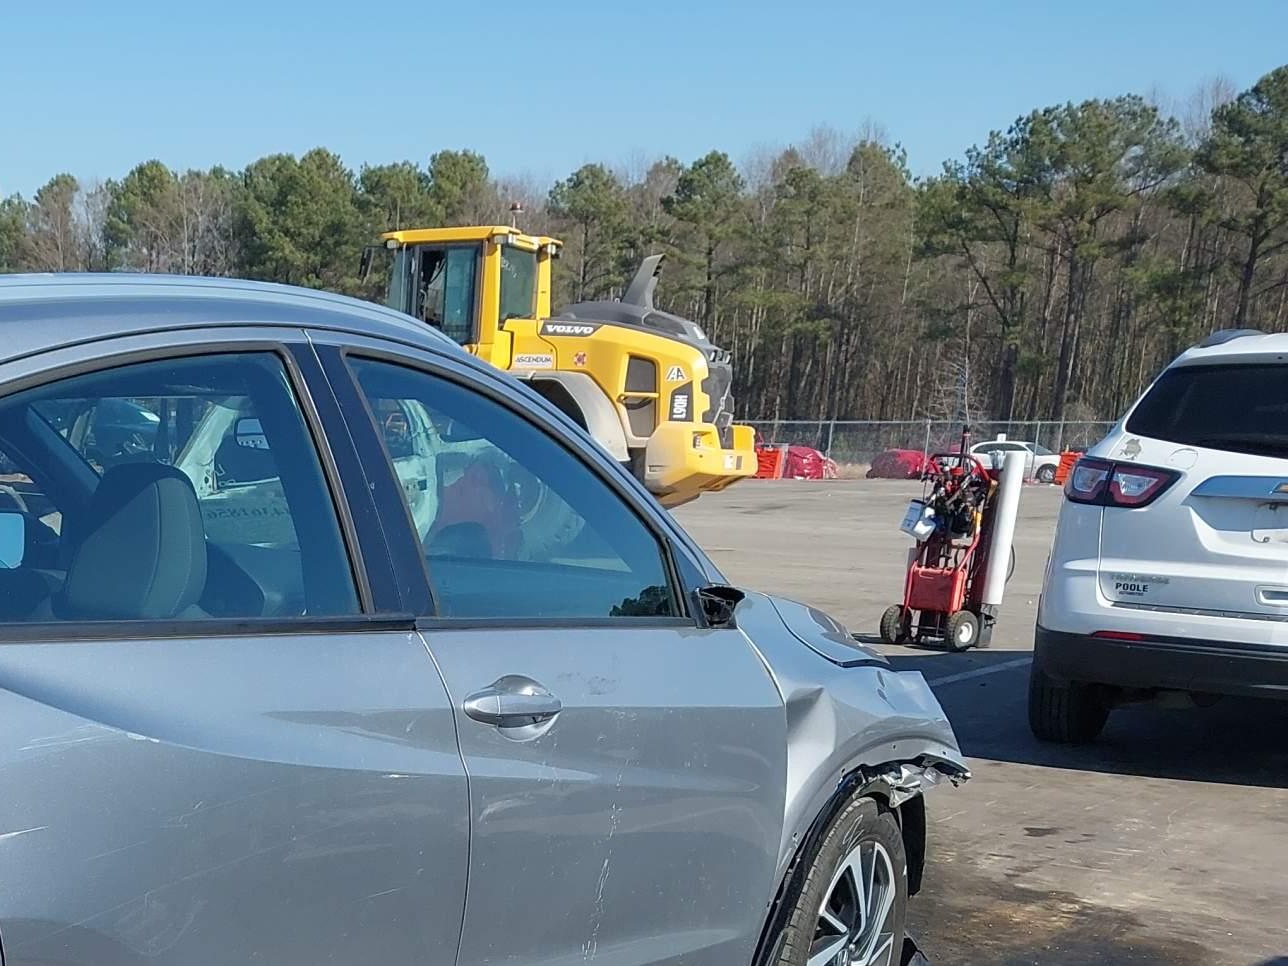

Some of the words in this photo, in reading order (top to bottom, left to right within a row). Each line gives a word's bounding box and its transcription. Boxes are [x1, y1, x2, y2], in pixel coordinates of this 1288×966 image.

[546, 324, 594, 334] VOLVO
[672, 394, 689, 419] L90H
[1115, 582, 1149, 593] POOLE
